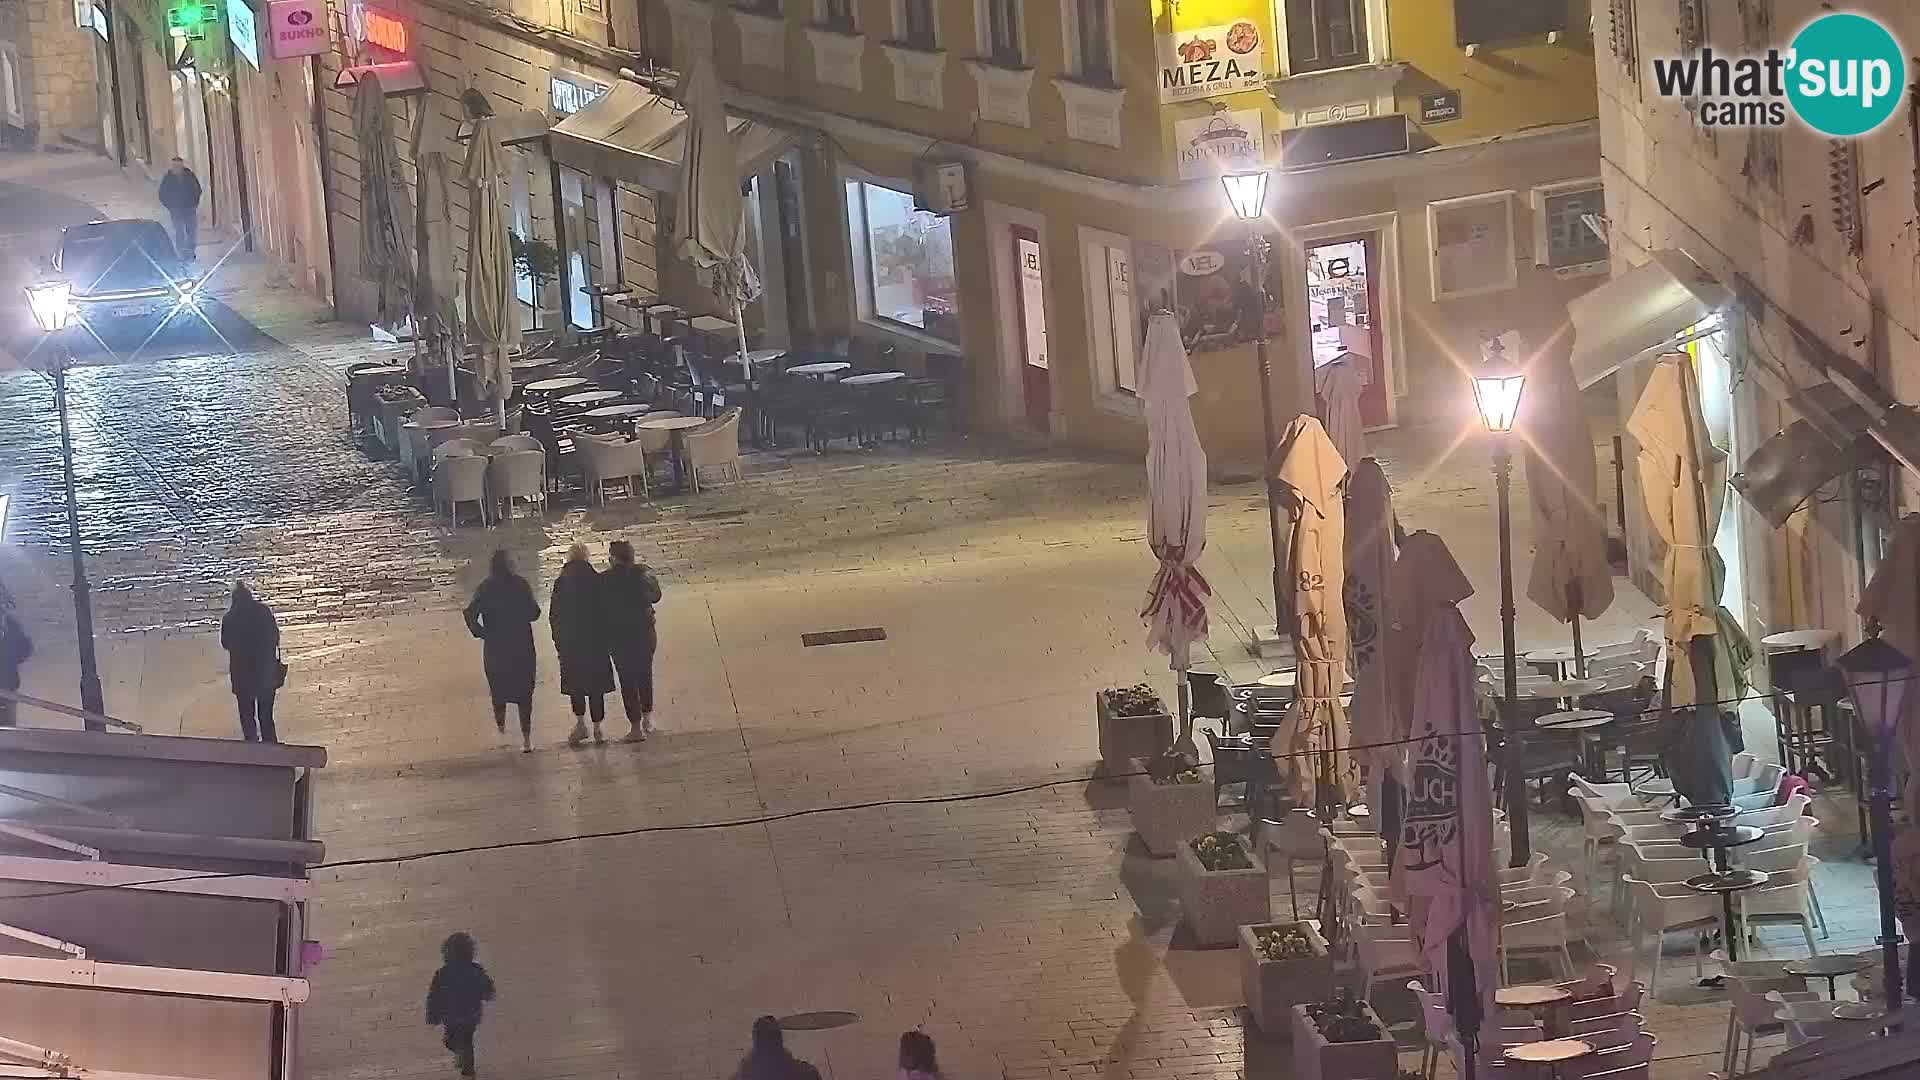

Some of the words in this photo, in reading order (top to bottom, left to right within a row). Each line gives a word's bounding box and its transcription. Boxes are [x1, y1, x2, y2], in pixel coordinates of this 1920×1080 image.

[1162, 58, 1242, 89] MEZA
[1172, 84, 1205, 97] PIZZERIA
[1212, 80, 1233, 91] GRILL
